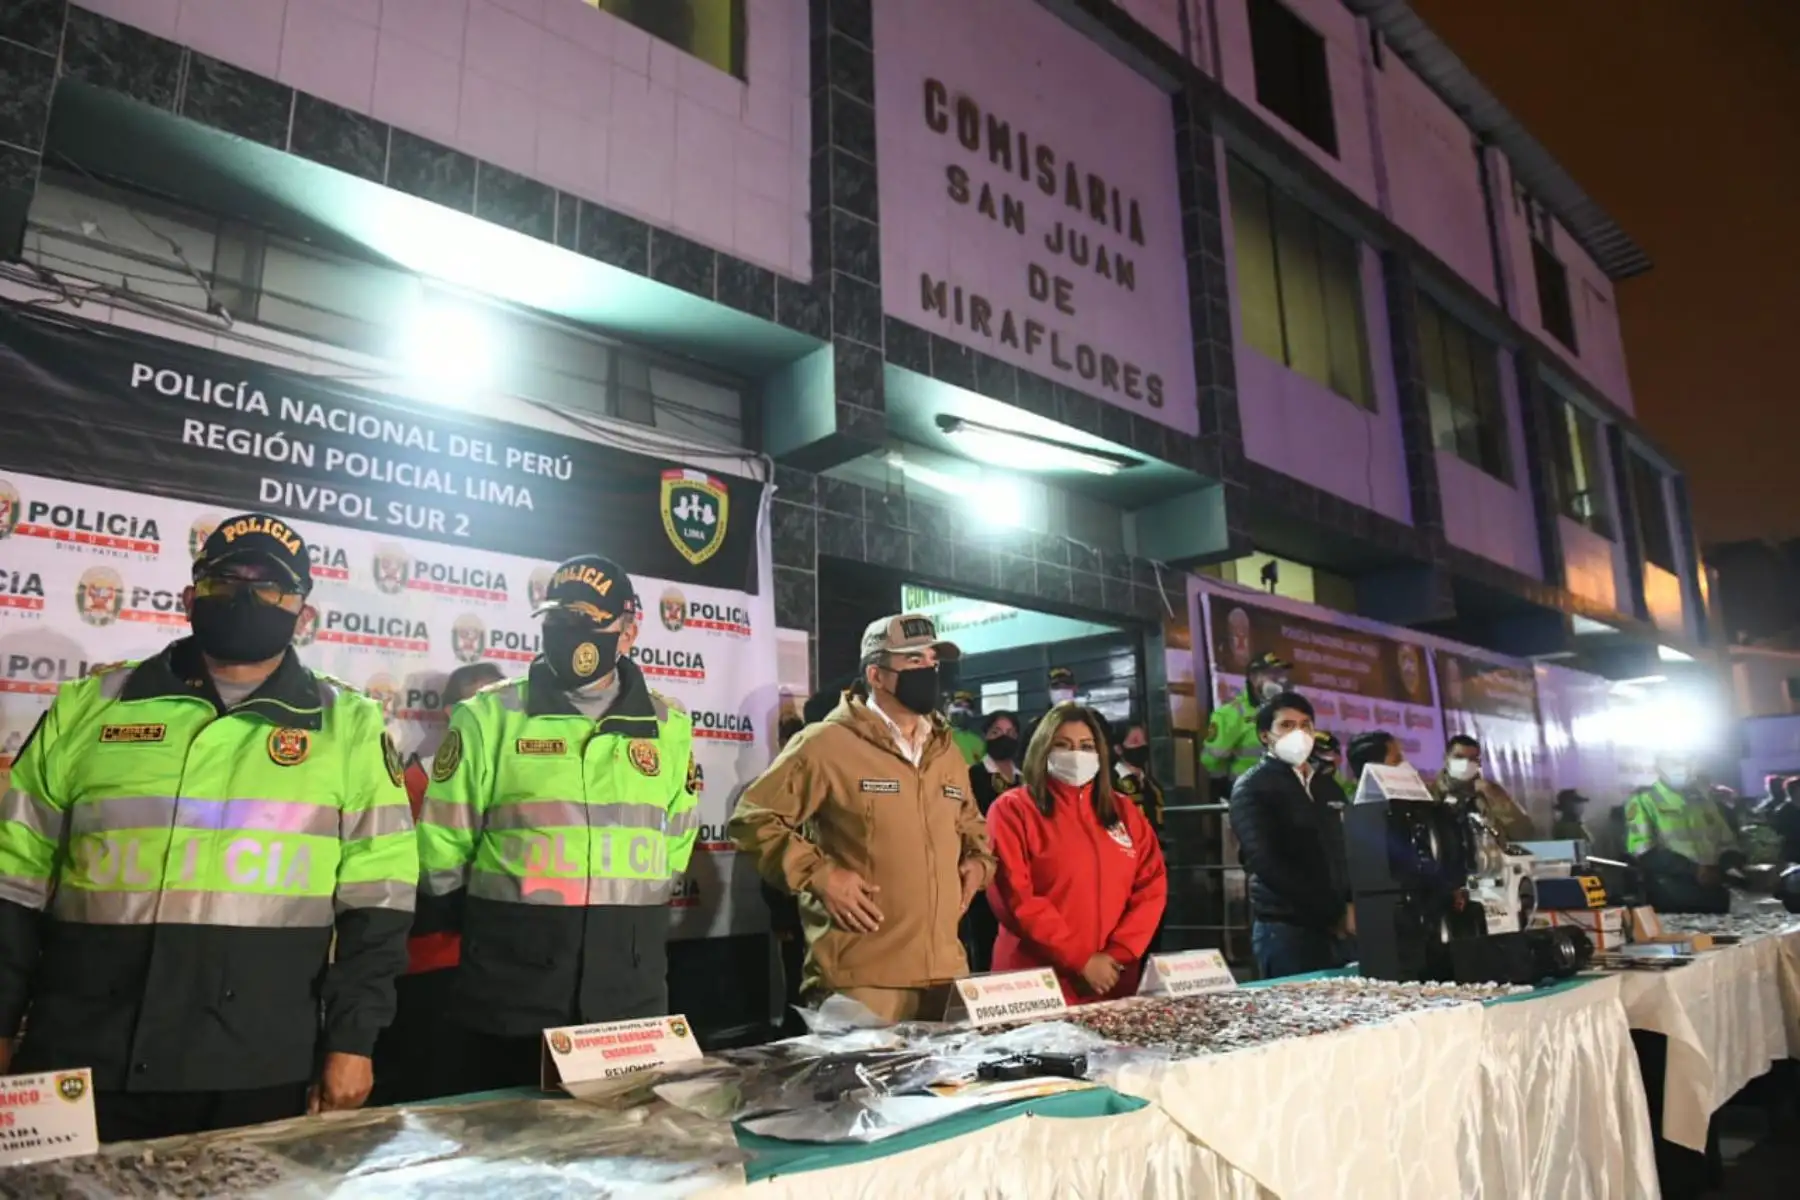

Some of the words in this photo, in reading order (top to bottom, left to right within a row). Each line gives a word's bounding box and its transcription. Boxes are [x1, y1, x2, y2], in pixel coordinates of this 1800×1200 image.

[923, 77, 1145, 247] COMISARIA
[945, 164, 1026, 235] SAN
[1045, 221, 1135, 292] JUAN
[1027, 262, 1076, 316] DE
[920, 272, 1164, 409] MIRAFLORES
[130, 362, 270, 417] POLICÍA
[280, 396, 440, 453] NACIONAL
[449, 434, 499, 467] DEL
[506, 447, 573, 481] PERÚ
[182, 418, 315, 468] REGIÓN
[325, 447, 457, 496] POLICIAL
[465, 479, 535, 511] LIMA
[222, 516, 302, 557] POLICIA
[259, 477, 378, 523] DIVPOL
[386, 501, 446, 534] SUR
[454, 513, 471, 537] 2
[976, 1004, 1008, 1020] DROGA
